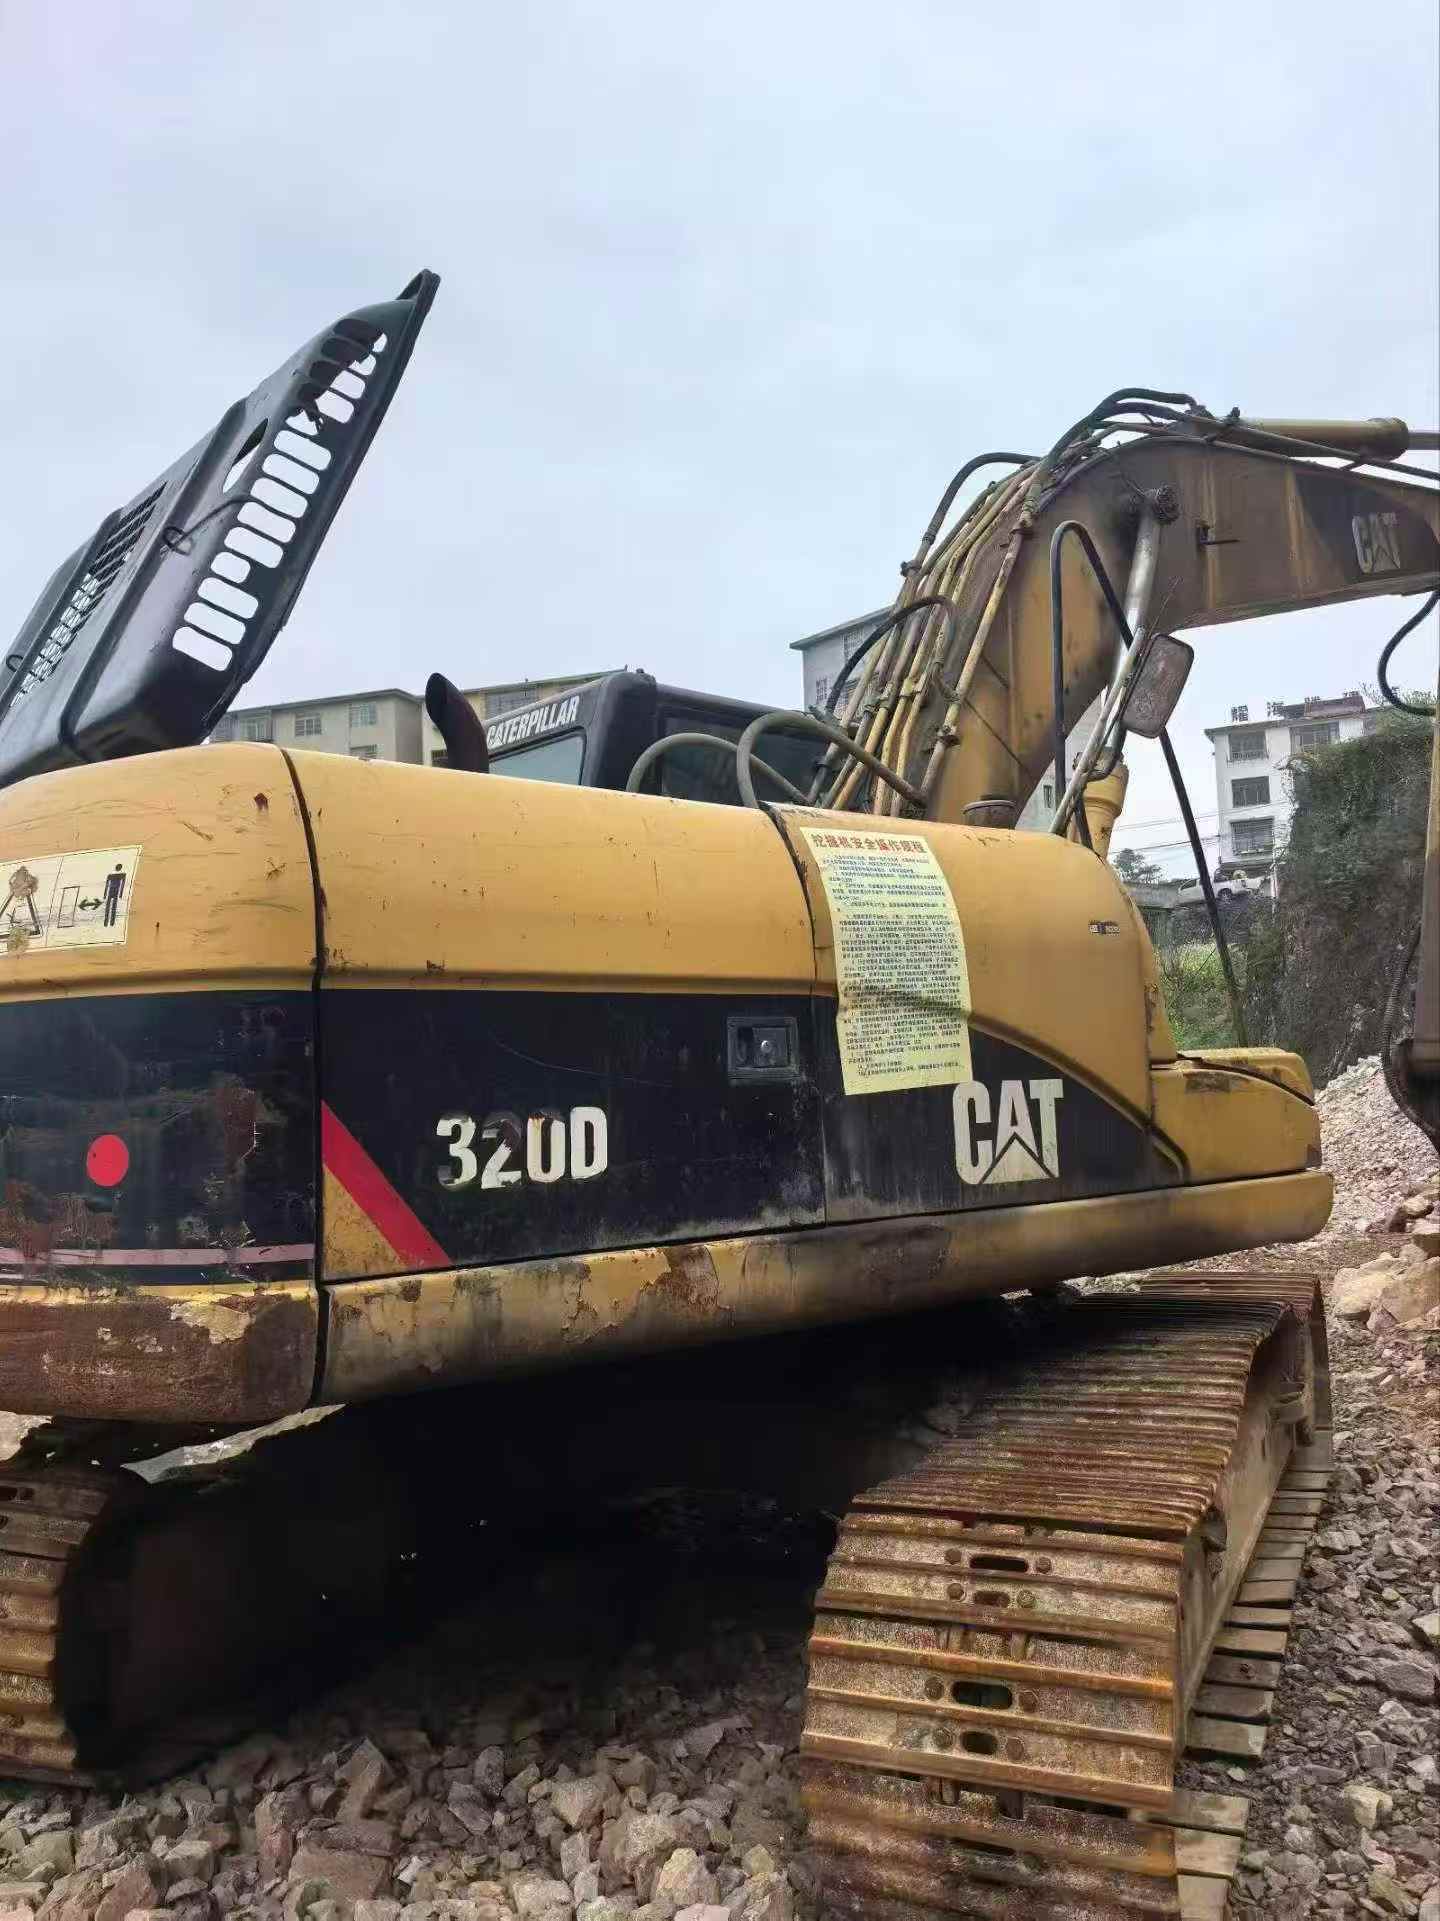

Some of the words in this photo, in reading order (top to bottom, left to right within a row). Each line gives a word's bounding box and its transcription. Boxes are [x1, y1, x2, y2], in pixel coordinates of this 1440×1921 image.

[1351, 512, 1400, 574] CAT
[487, 696, 580, 750] CATERPILLAR
[436, 1107, 608, 1190] 320D
[952, 1079, 1064, 1184] CAT
